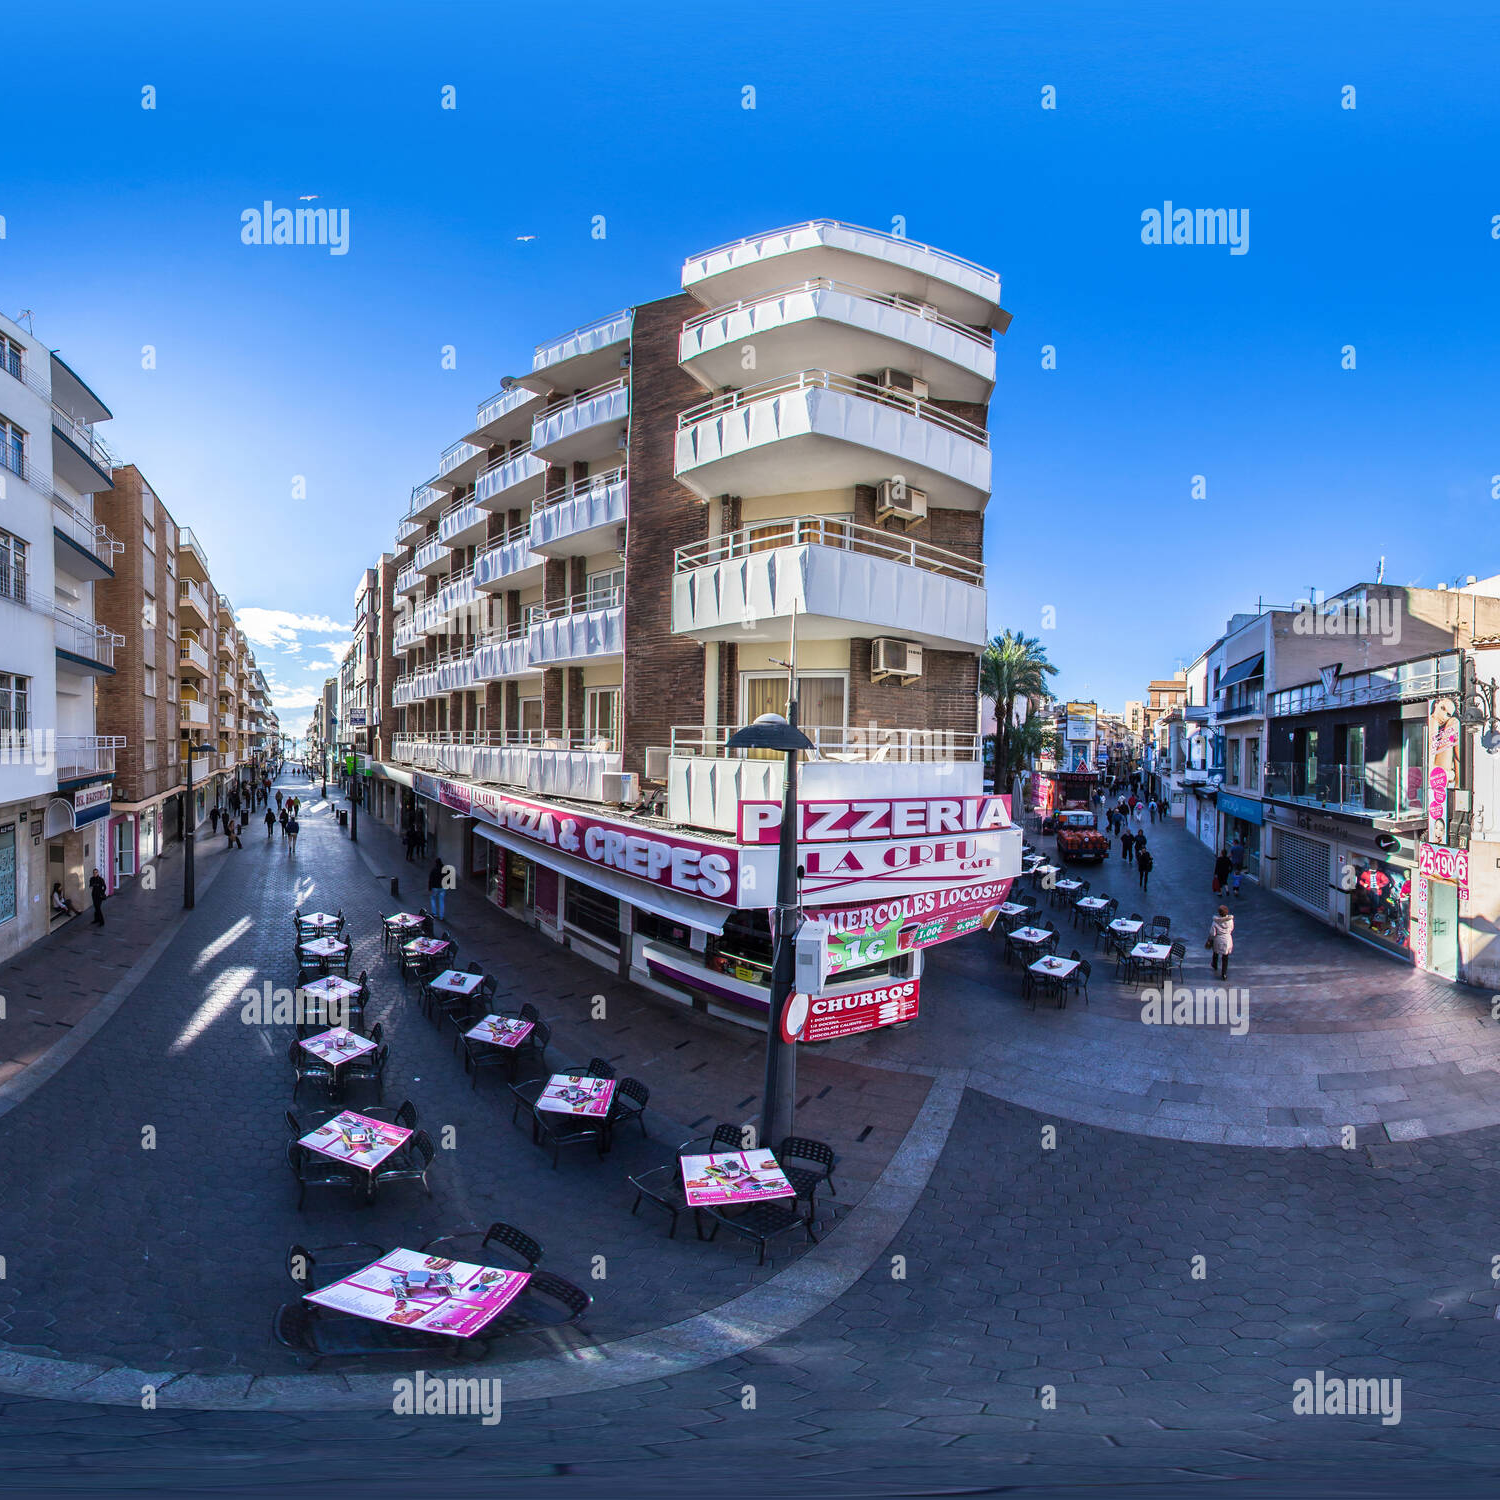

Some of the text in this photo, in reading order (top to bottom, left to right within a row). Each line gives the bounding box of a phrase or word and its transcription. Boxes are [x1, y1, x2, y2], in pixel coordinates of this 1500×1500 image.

[742, 799, 1012, 842] PIZZERIA
[500, 800, 556, 844] PIZZA
[559, 818, 581, 852] &
[584, 826, 732, 898] CREPES
[806, 840, 977, 874] LA CREU
[818, 893, 936, 936] MIERCOLES
[938, 884, 1006, 909] LOCOS!!!
[845, 939, 886, 968] 1€
[811, 983, 914, 1015] CHURROS
[810, 1025, 839, 1034] CHOCOLATE
[810, 1031, 839, 1039] CHOCOLATE
